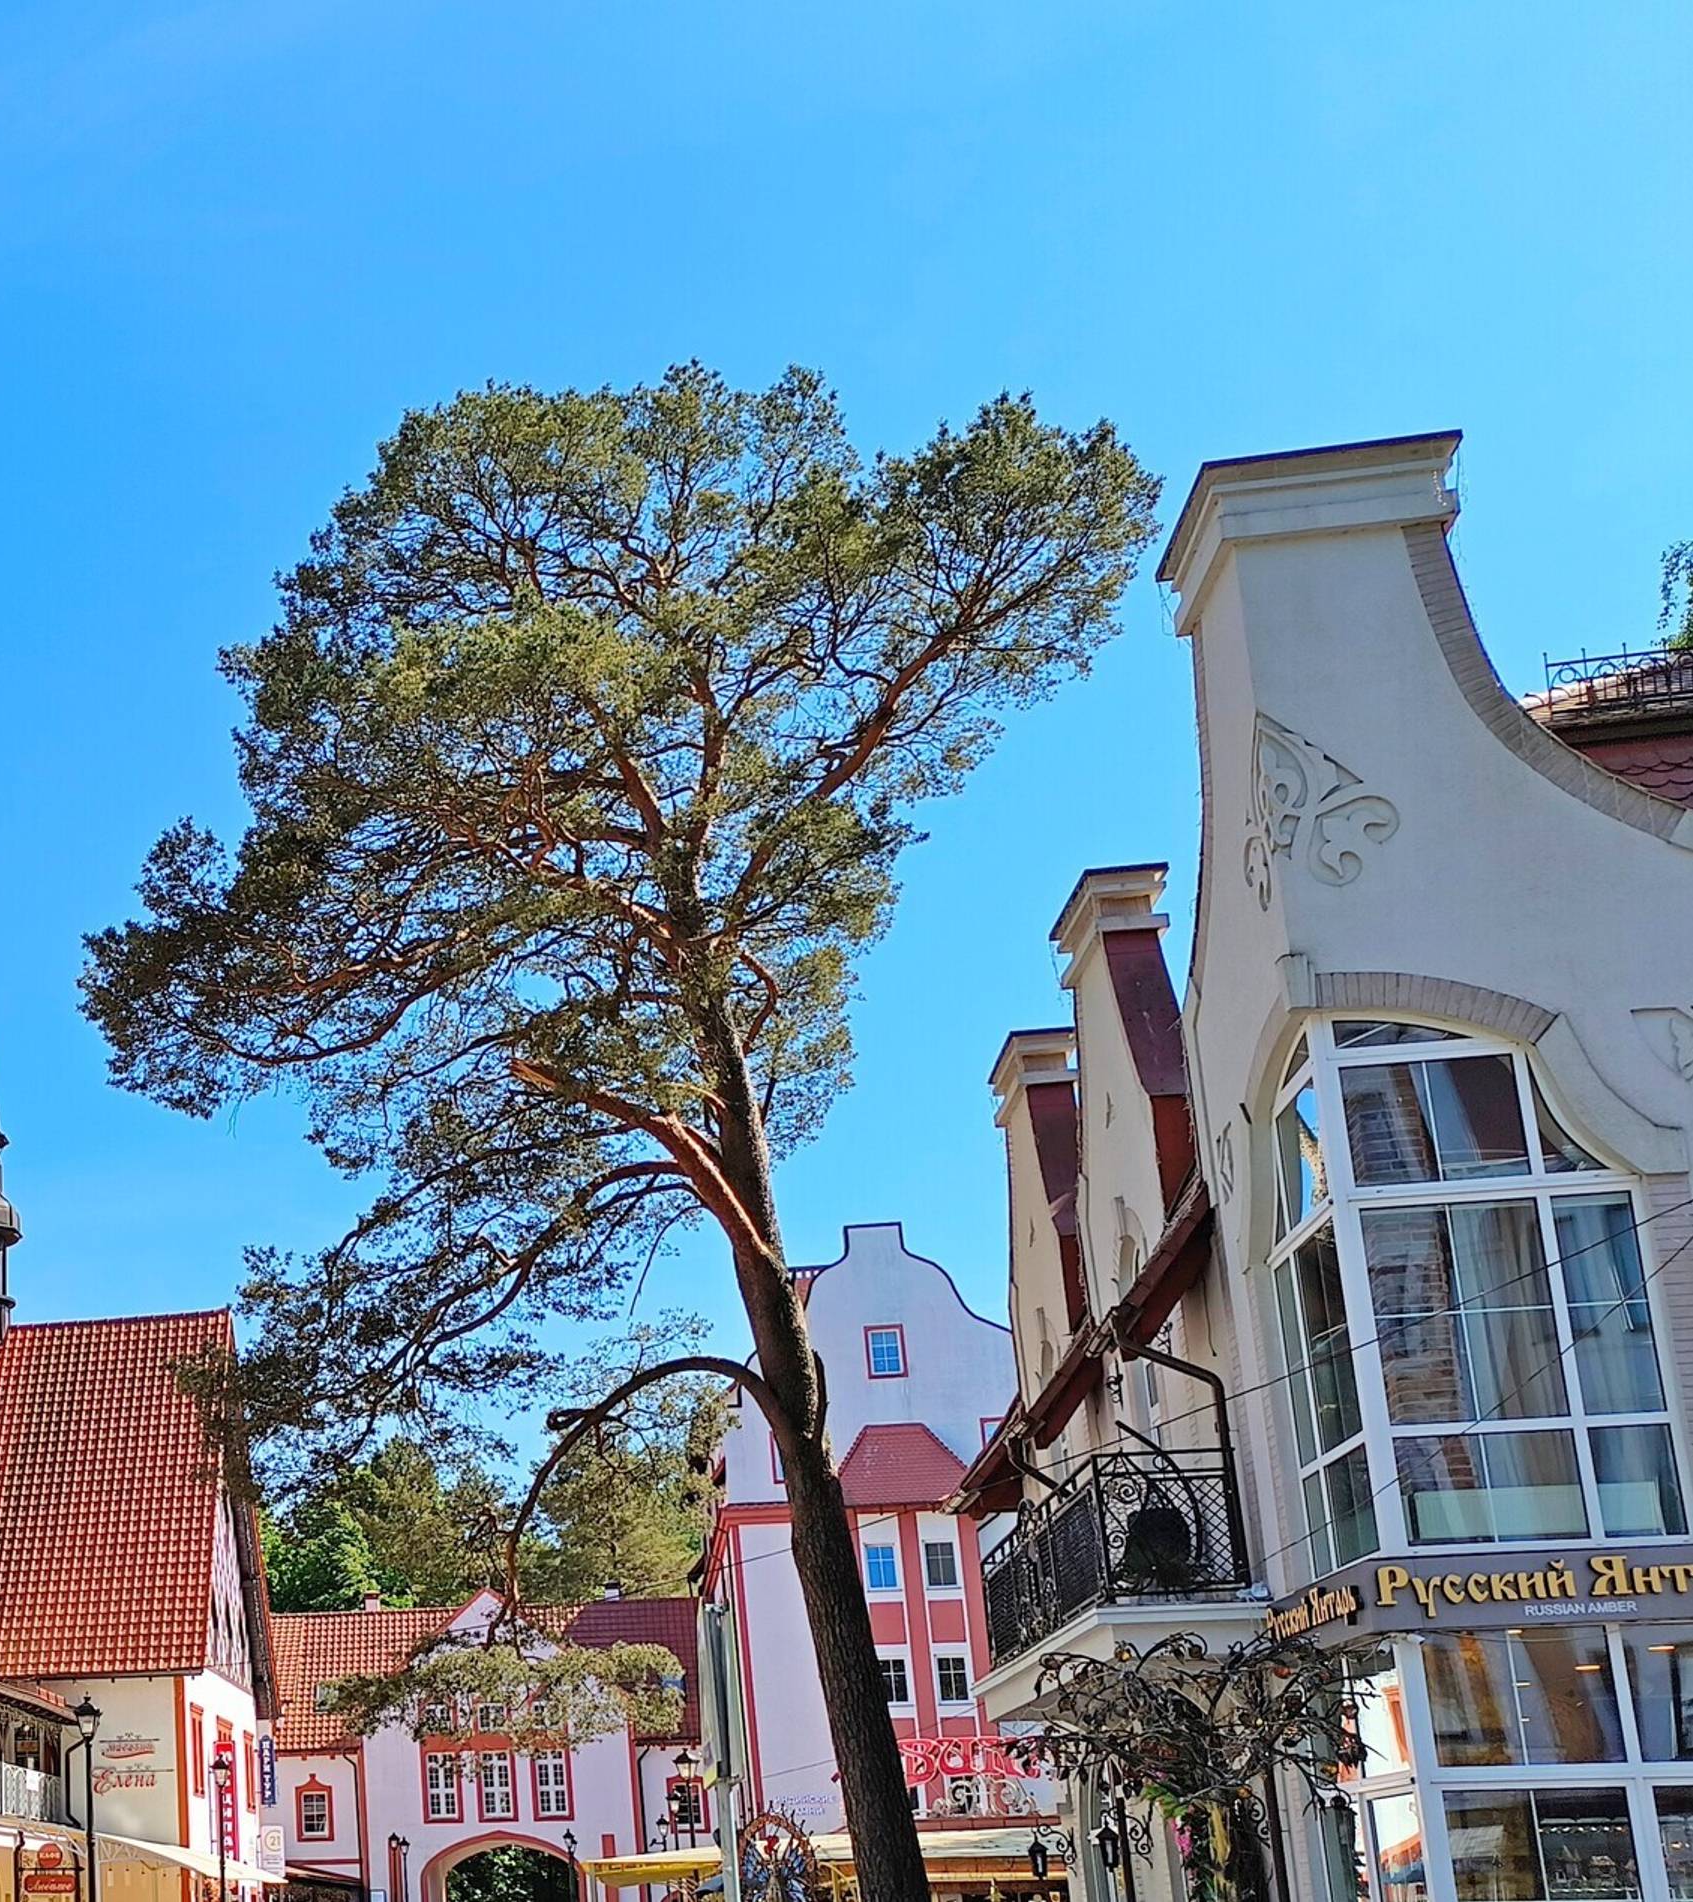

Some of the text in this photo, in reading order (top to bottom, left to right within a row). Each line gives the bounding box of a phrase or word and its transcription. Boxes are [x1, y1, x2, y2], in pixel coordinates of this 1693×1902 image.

[1376, 1558, 1577, 1617] Русский
[1309, 1586, 1356, 1626] Янтарь
[1525, 1601, 1637, 1616] RUSSIAN AMBER
[92, 1767, 157, 1796] Елена
